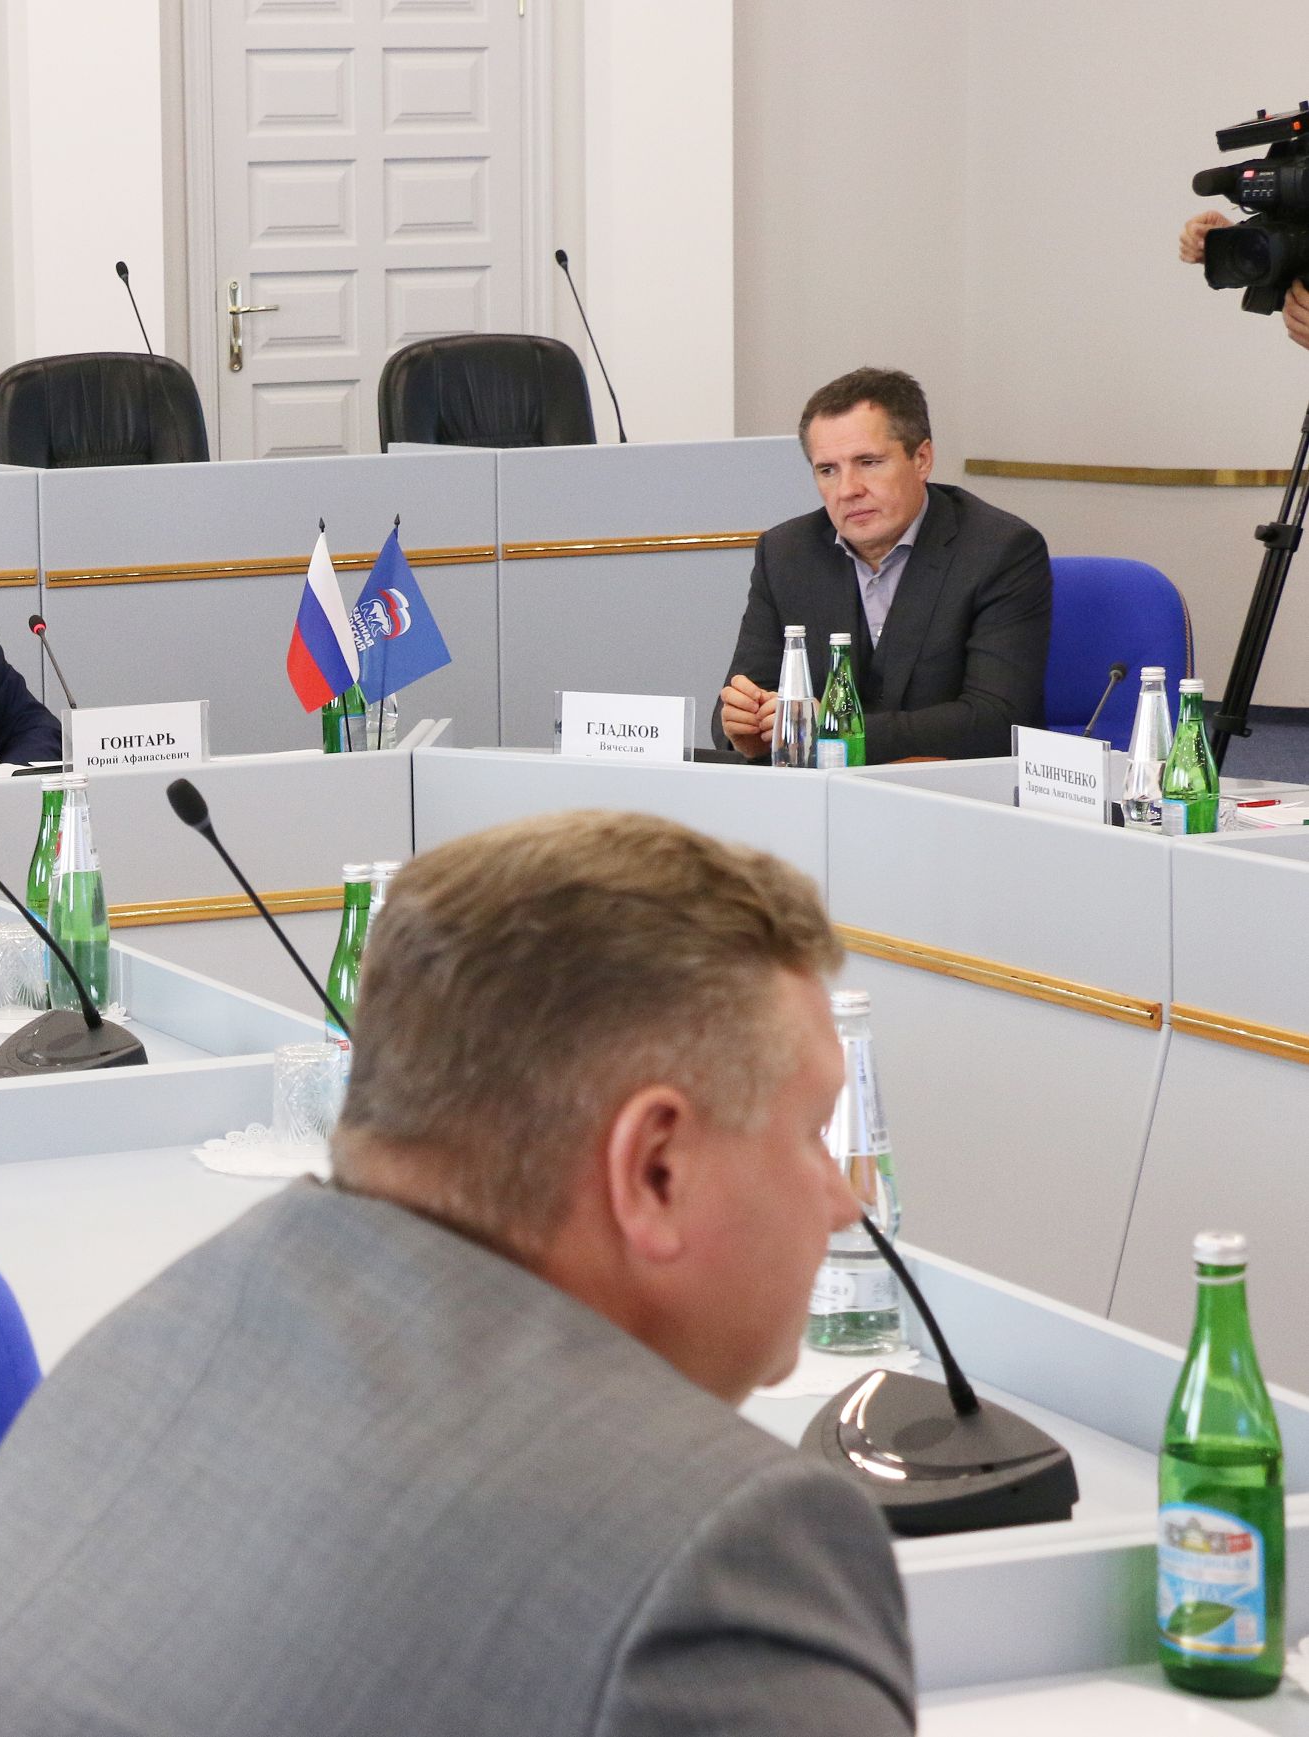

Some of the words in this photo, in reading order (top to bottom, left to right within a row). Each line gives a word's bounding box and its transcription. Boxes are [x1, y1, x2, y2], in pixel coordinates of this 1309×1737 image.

[349, 611, 367, 652] ОССИЯ
[586, 721, 660, 739] ГЛАДКОВ
[100, 732, 176, 750] ГОНТАРЬ
[599, 741, 645, 753] Вячеслав
[87, 755, 119, 767] Юрий
[121, 751, 190, 765] Афанасьевич
[1025, 760, 1097, 789] КАЛИНЧЕНКО
[1025, 780, 1050, 796] Лариса
[1052, 787, 1096, 806] Анатольевна
